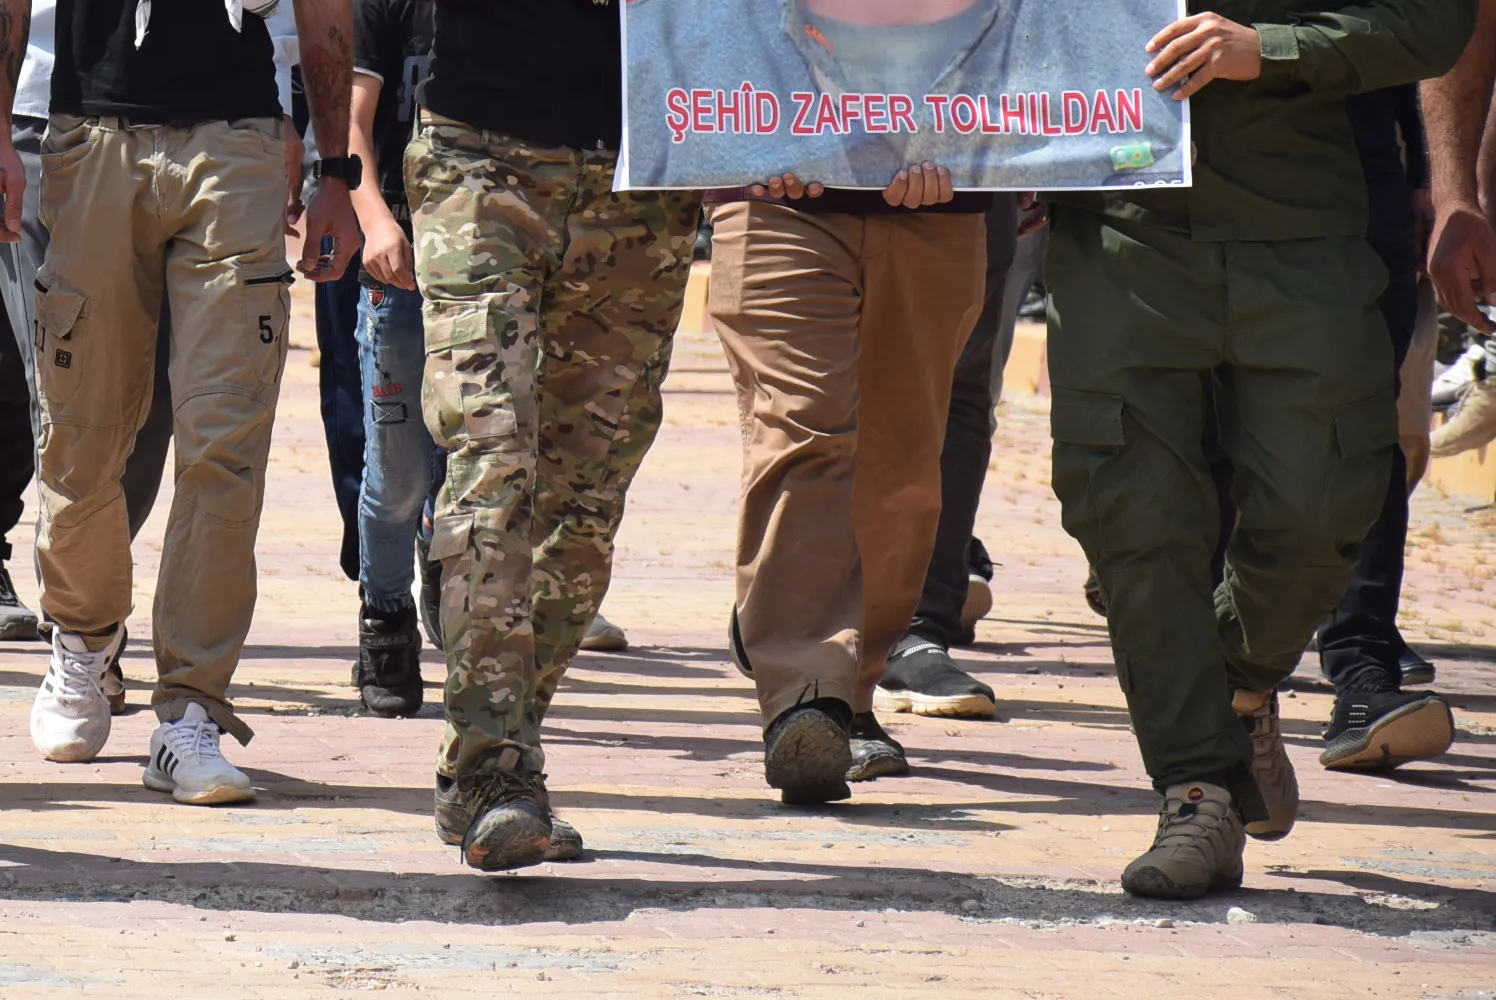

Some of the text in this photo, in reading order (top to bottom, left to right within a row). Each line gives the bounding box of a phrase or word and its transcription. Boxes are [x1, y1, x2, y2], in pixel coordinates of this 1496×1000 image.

[665, 80, 1143, 144] ŞEHÎD ZAFER TOLHILDAN
